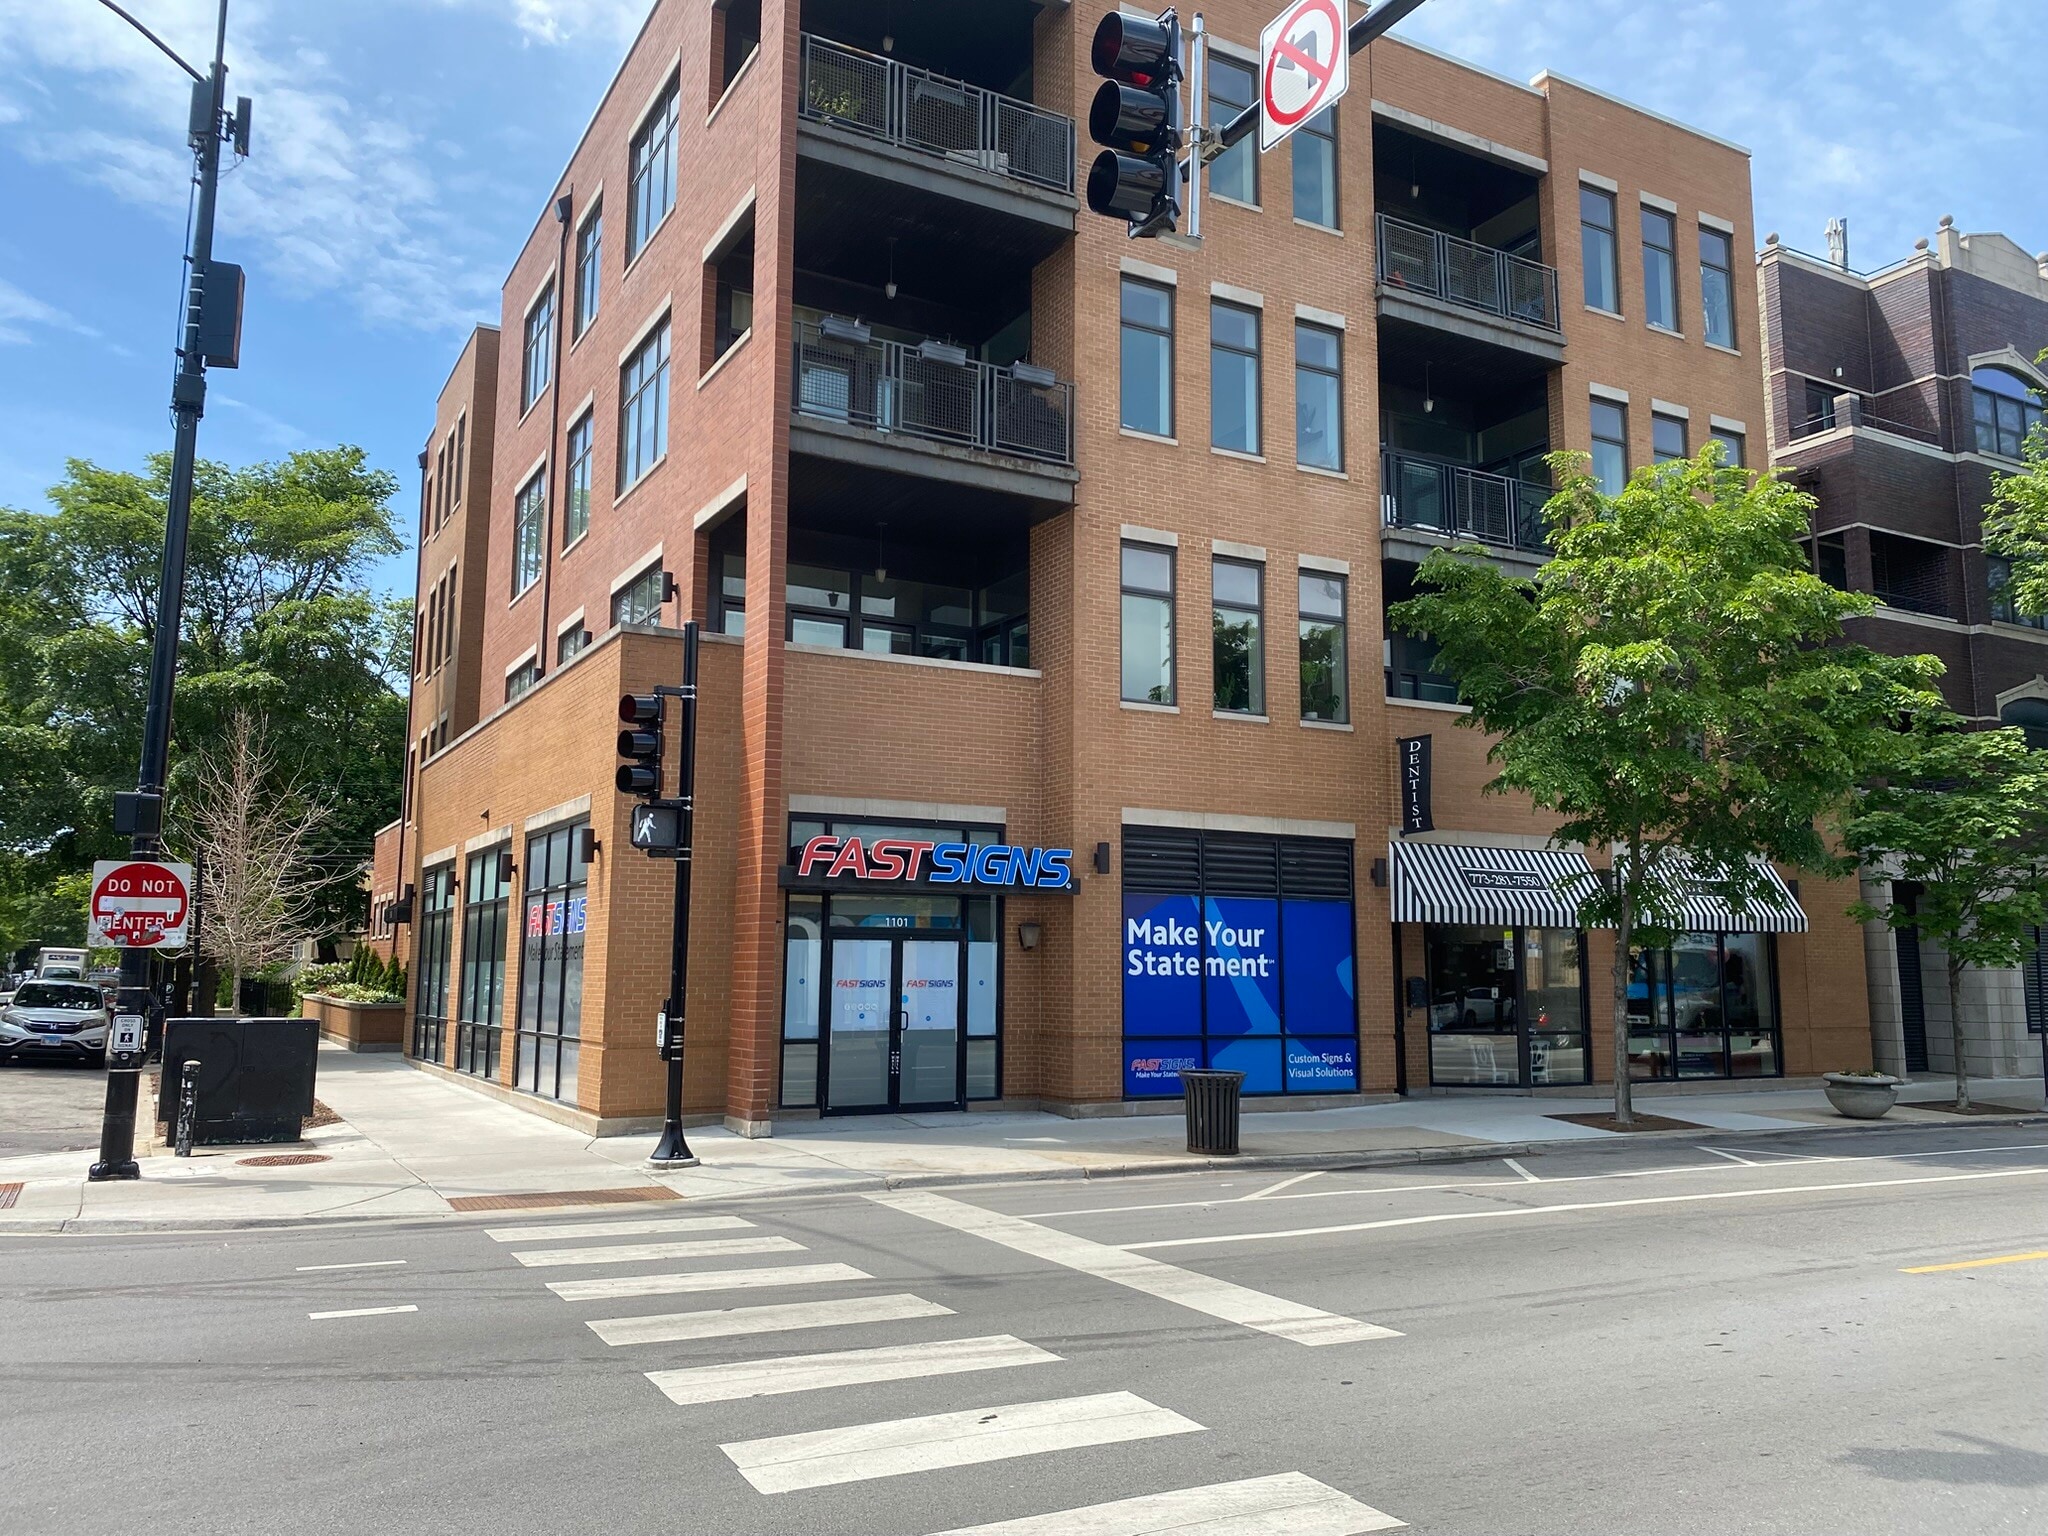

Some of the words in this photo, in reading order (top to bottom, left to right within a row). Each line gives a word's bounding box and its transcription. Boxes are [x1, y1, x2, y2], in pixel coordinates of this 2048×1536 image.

[1408, 740, 1423, 829] DENTIST
[108, 879, 131, 892] DO
[142, 880, 176, 893] NOT
[1468, 873, 1541, 887] 773-281-7550
[112, 917, 166, 930] ENTER
[884, 916, 909, 928] 1101
[1127, 917, 1199, 946] Make
[1204, 920, 1265, 948] Your
[1127, 948, 1269, 977] Statement
[836, 979, 886, 989] FASTSIGNS
[906, 979, 954, 989] FASTSIGNS
[1131, 1058, 1196, 1071] FASTSIGNS
[1288, 1053, 1320, 1064] Custom
[1321, 1052, 1343, 1065] Signs
[1344, 1052, 1352, 1063] &
[1288, 1067, 1314, 1078] Visual
[1315, 1066, 1354, 1078] Solutions
